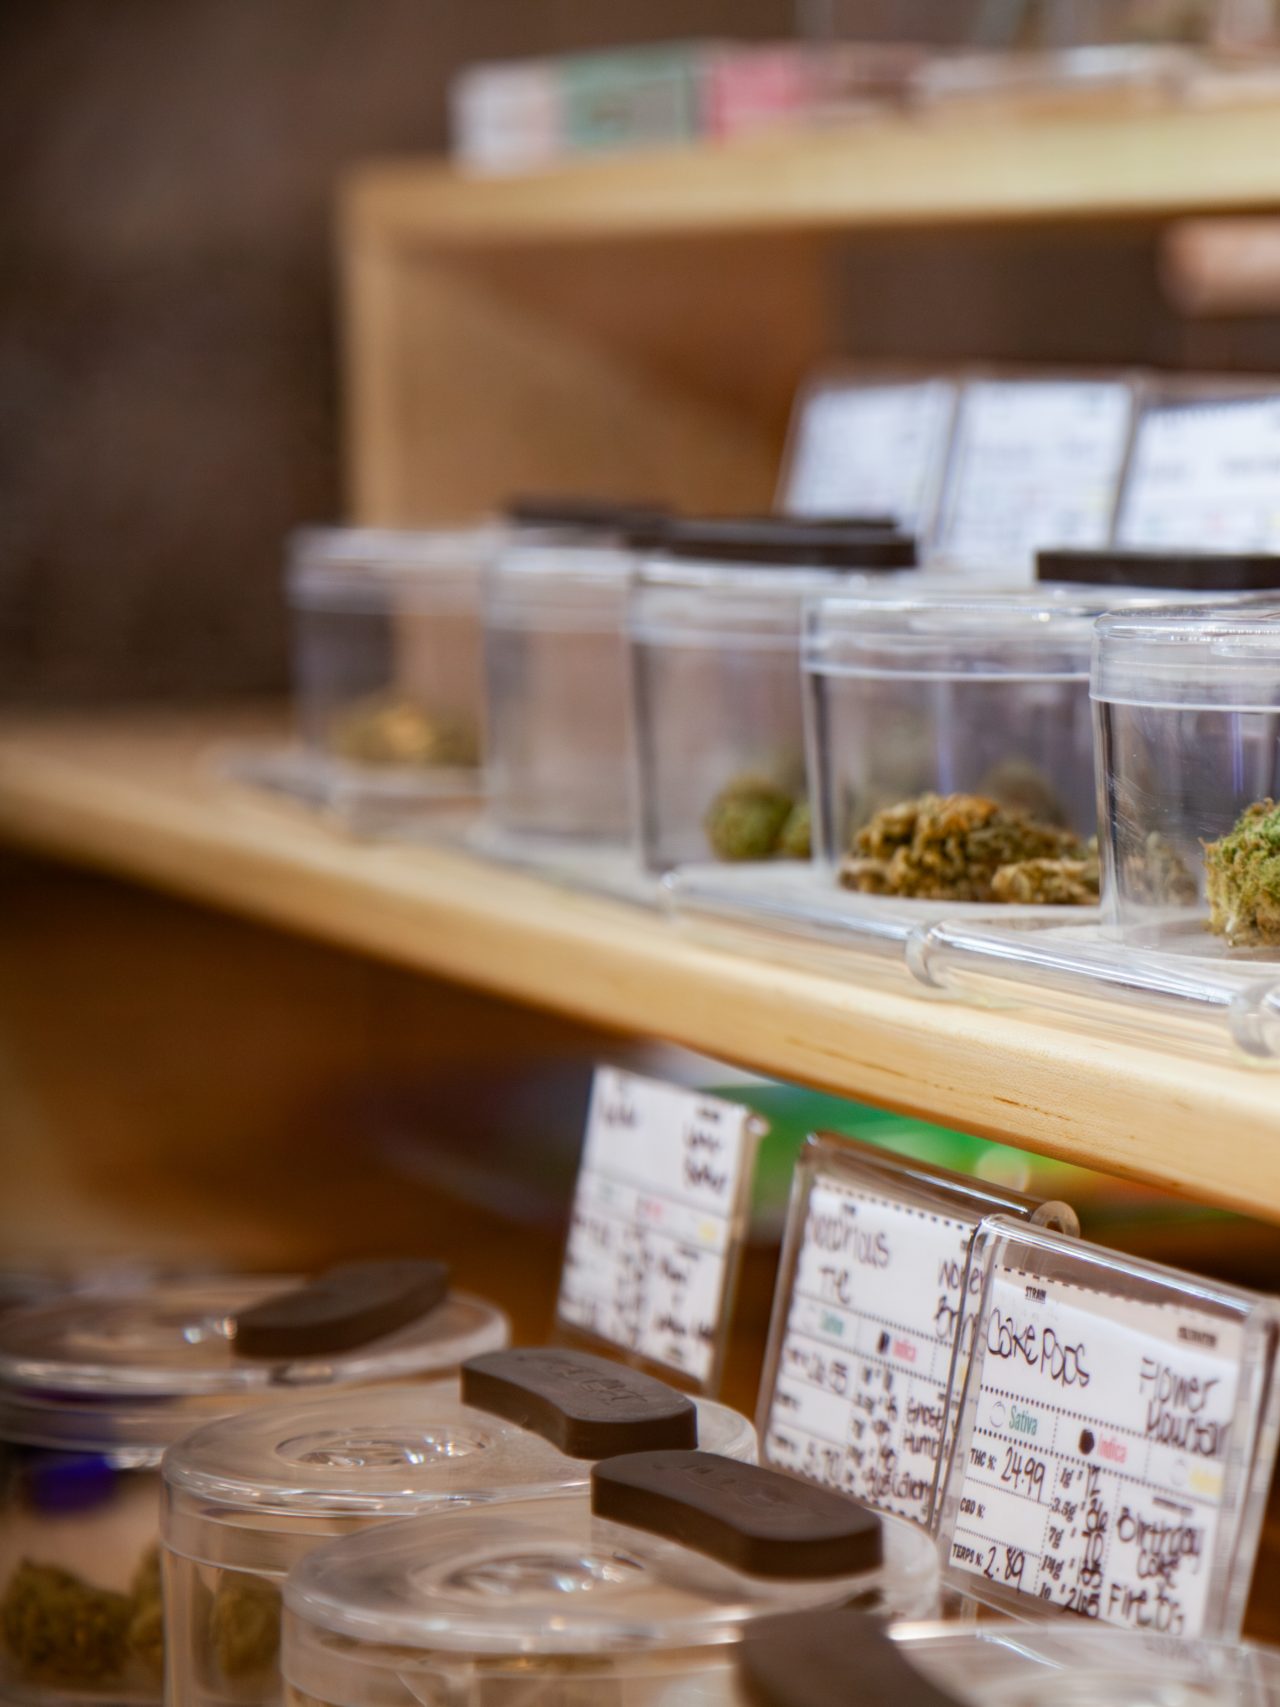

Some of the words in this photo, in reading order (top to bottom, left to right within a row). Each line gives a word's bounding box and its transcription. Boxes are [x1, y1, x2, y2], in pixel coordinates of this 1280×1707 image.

[1009, 1405, 1039, 1437] Sativa
[971, 1447, 986, 1468] THC
[1001, 1446, 1046, 1502] 24.99
[959, 1497, 976, 1514] CBD
[952, 1543, 975, 1565] TERPS
[983, 1546, 1027, 1595] 2.89
